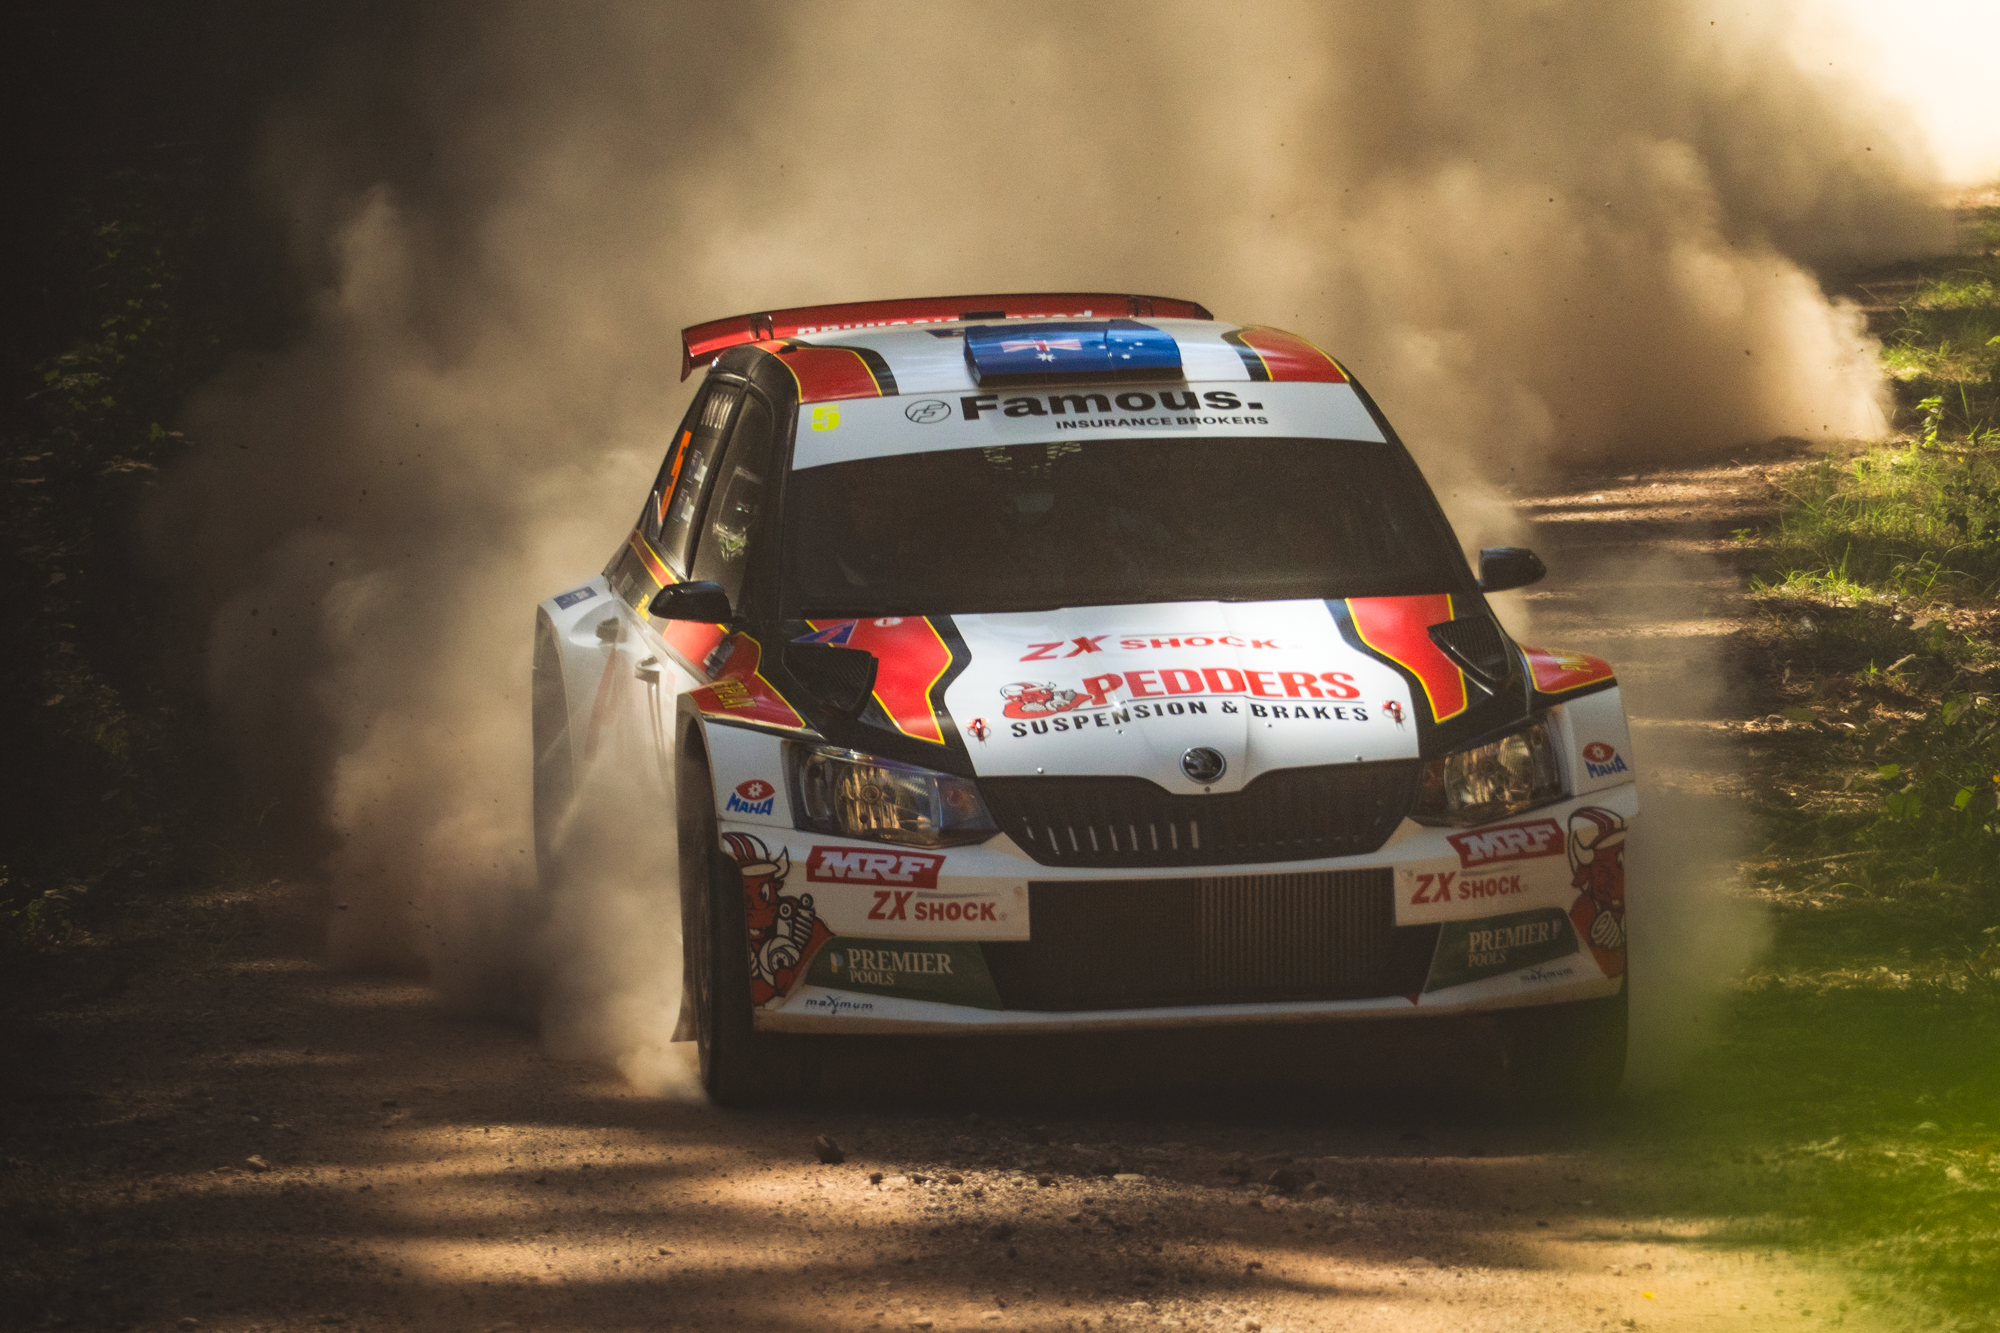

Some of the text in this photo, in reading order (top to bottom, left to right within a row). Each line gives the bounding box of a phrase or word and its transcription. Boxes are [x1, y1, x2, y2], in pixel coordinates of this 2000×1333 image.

[811, 405, 841, 432] 5
[1056, 416, 1269, 430] INSURANCE BROKERS
[1019, 635, 1283, 662] ZX SHOCK
[1081, 667, 1361, 706] PEDDERS
[1010, 700, 1369, 738] SUSPENSION & BRAKES
[1585, 753, 1628, 779] MAHA
[726, 792, 775, 816] MAHA
[1459, 824, 1557, 861] MRF
[814, 851, 936, 883] MRF
[1410, 871, 1521, 905] ZX SHOCK
[867, 890, 996, 921] ZX SHOCK
[1468, 921, 1549, 953] PREMIER
[847, 949, 954, 975] PREMIER
[850, 970, 896, 986] POOLS
